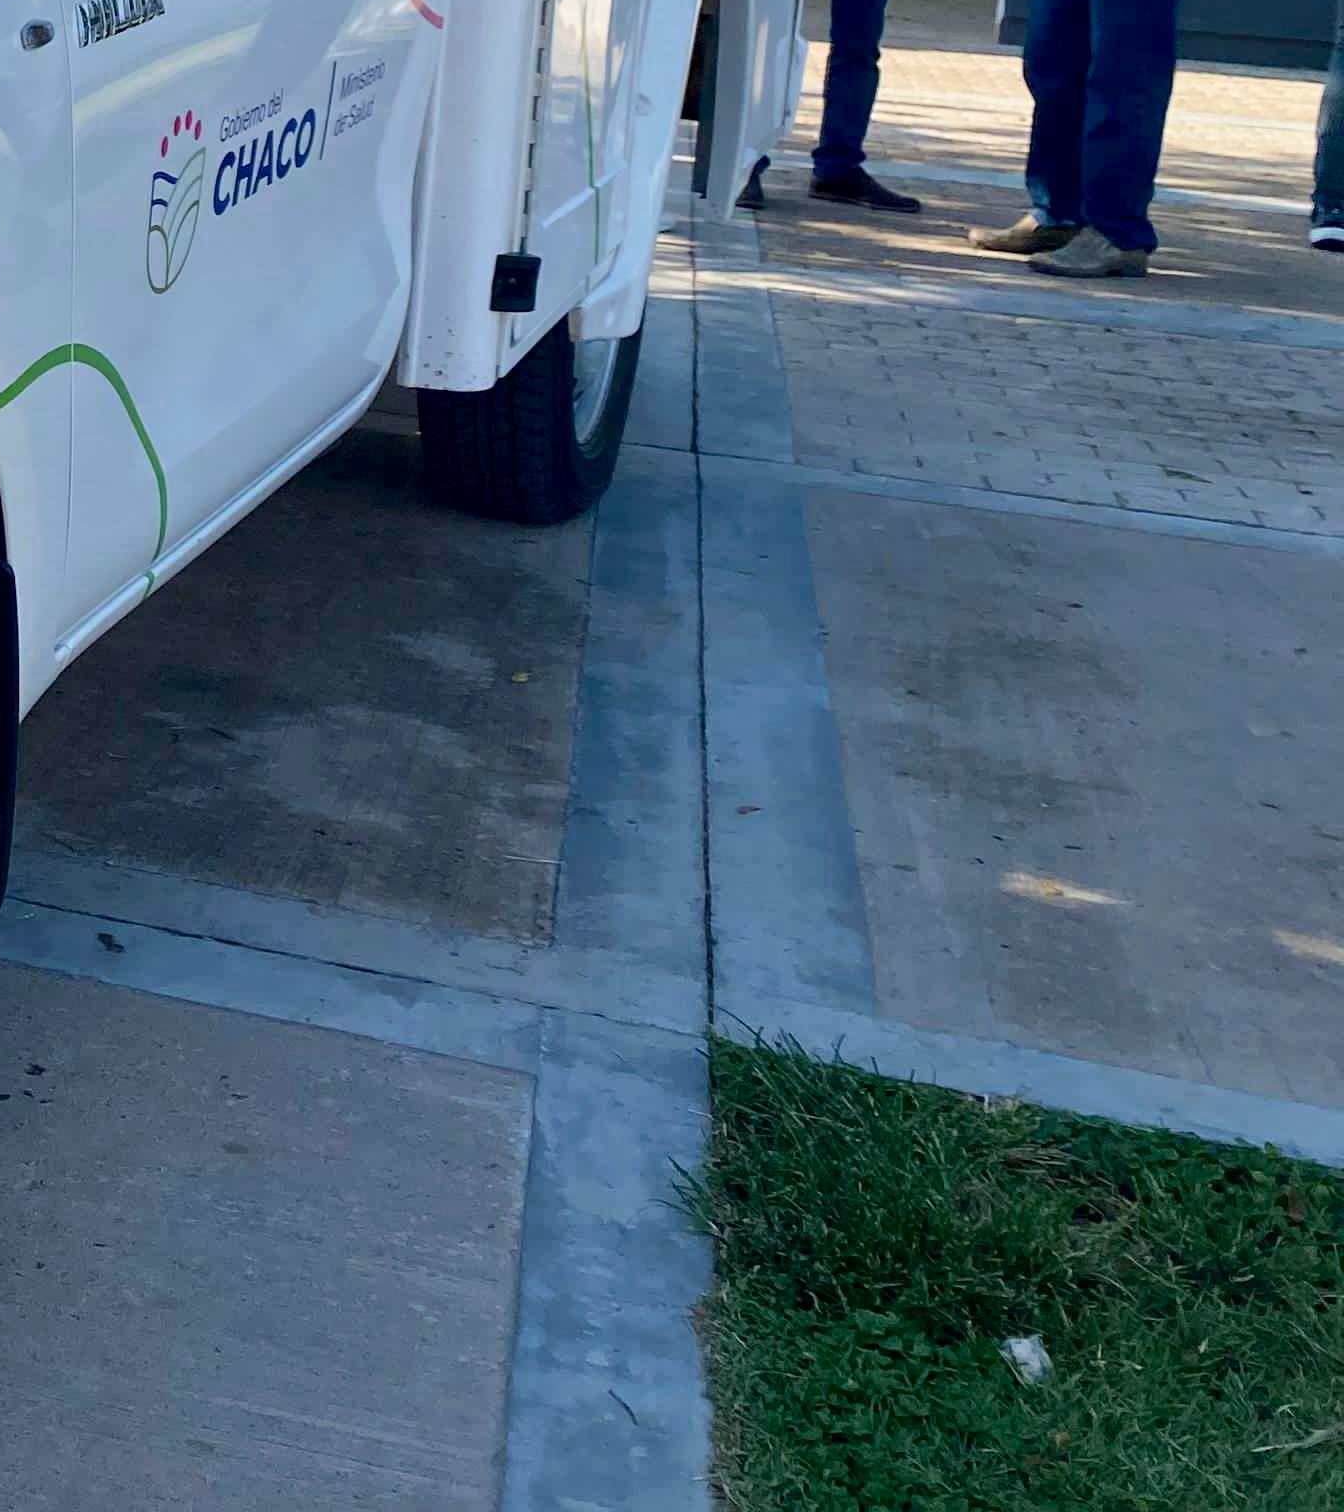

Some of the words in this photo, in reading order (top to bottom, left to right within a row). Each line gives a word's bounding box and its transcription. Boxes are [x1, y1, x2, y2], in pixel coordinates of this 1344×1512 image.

[340, 58, 386, 100] Ministerio
[219, 101, 267, 143] Gobierno
[267, 88, 284, 119] del
[213, 108, 316, 216] CHACO
